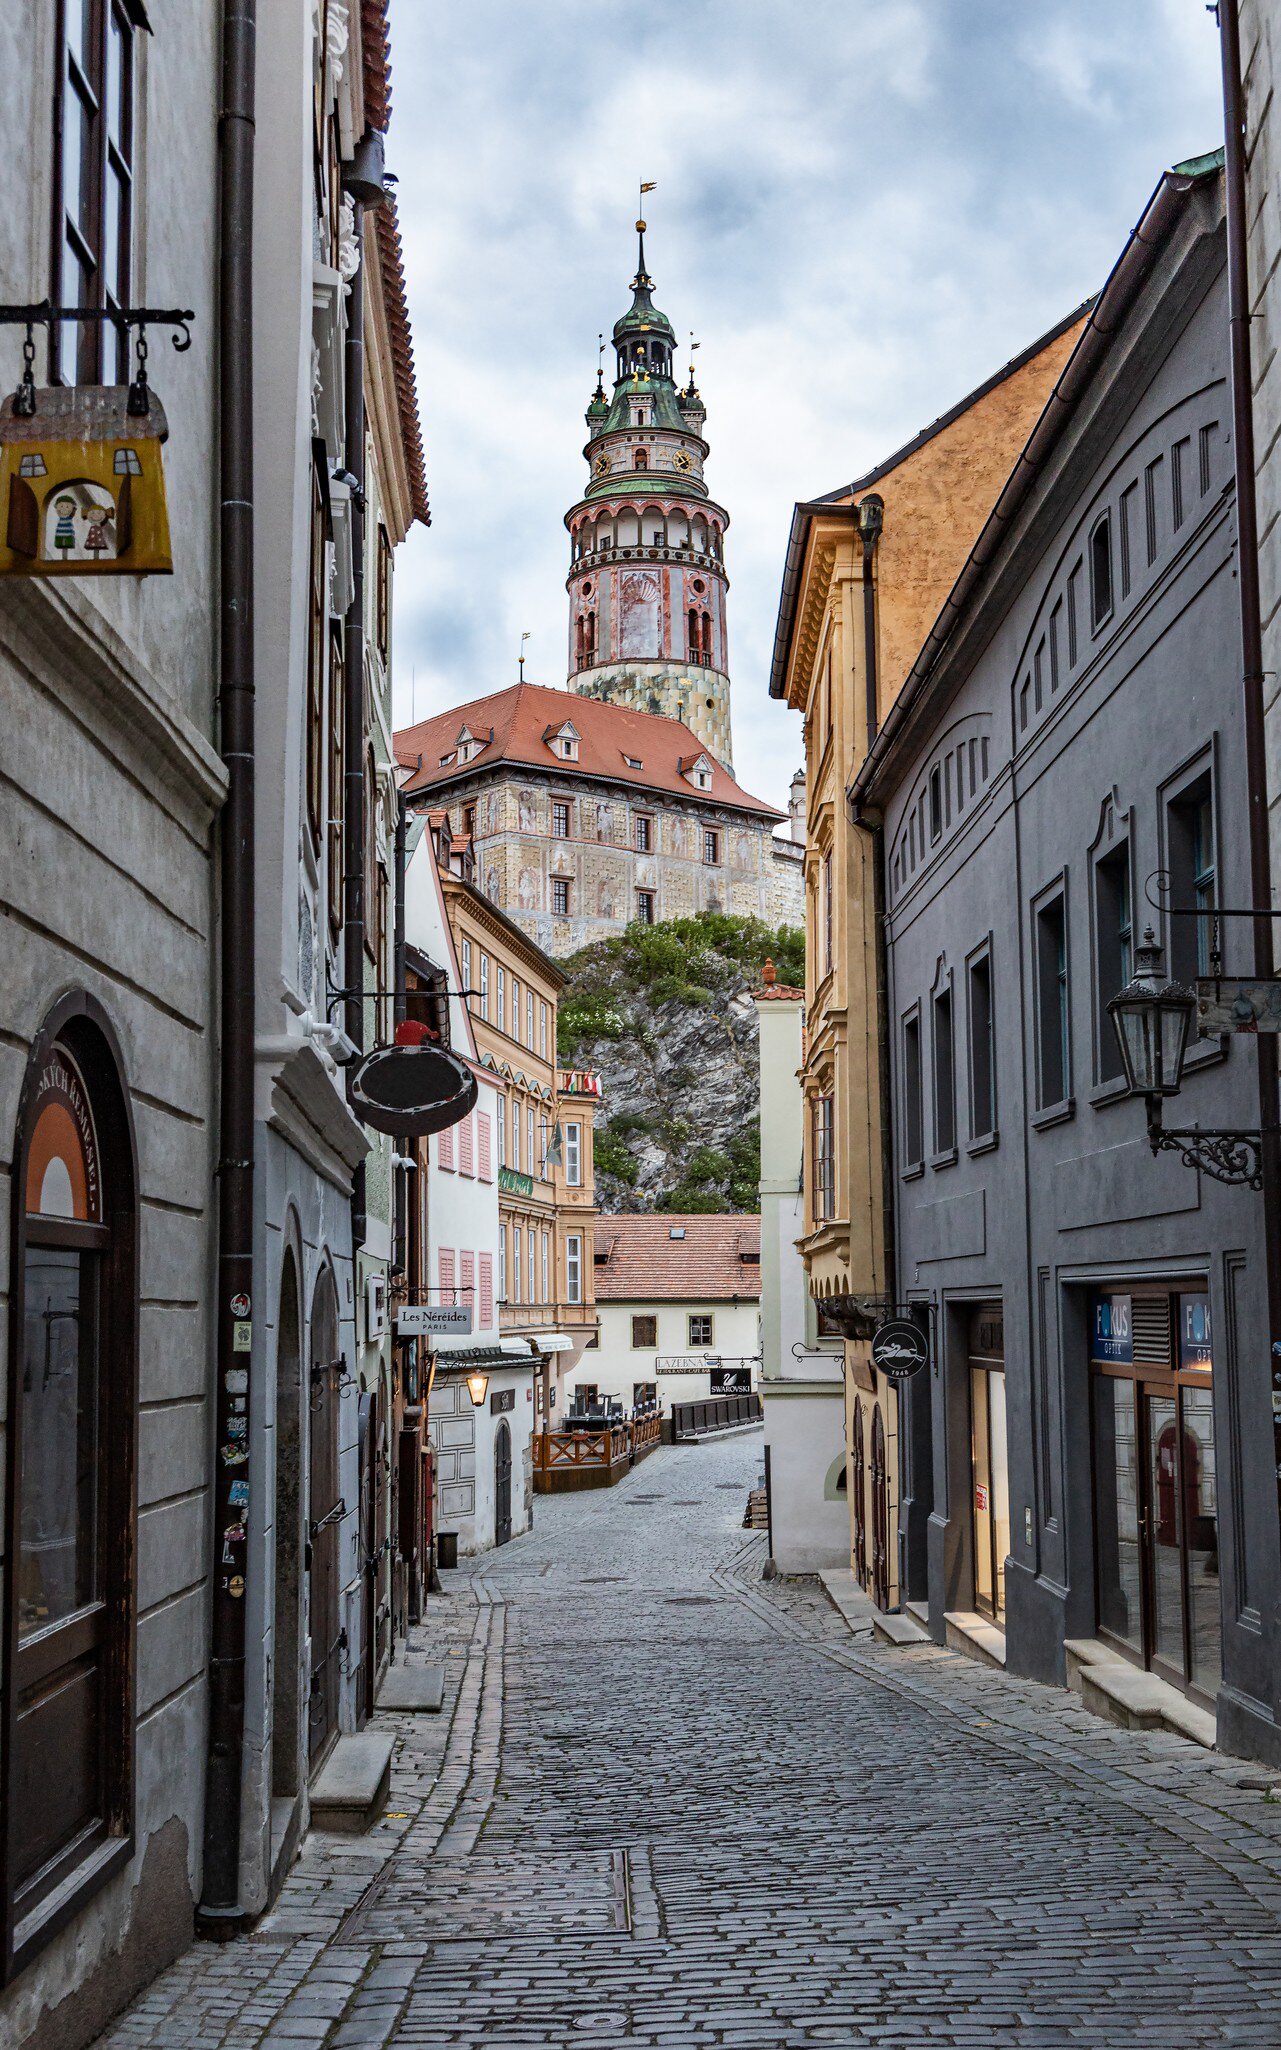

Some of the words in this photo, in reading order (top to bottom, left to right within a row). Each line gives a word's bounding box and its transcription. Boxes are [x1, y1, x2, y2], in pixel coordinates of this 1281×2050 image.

[402, 1311, 420, 1322] Les
[422, 1311, 468, 1322] Néréides
[1096, 1302, 1128, 1337] FOKUS
[1104, 1342, 1122, 1355] OPTIK
[711, 1385, 750, 1393] SWAROVSKI
